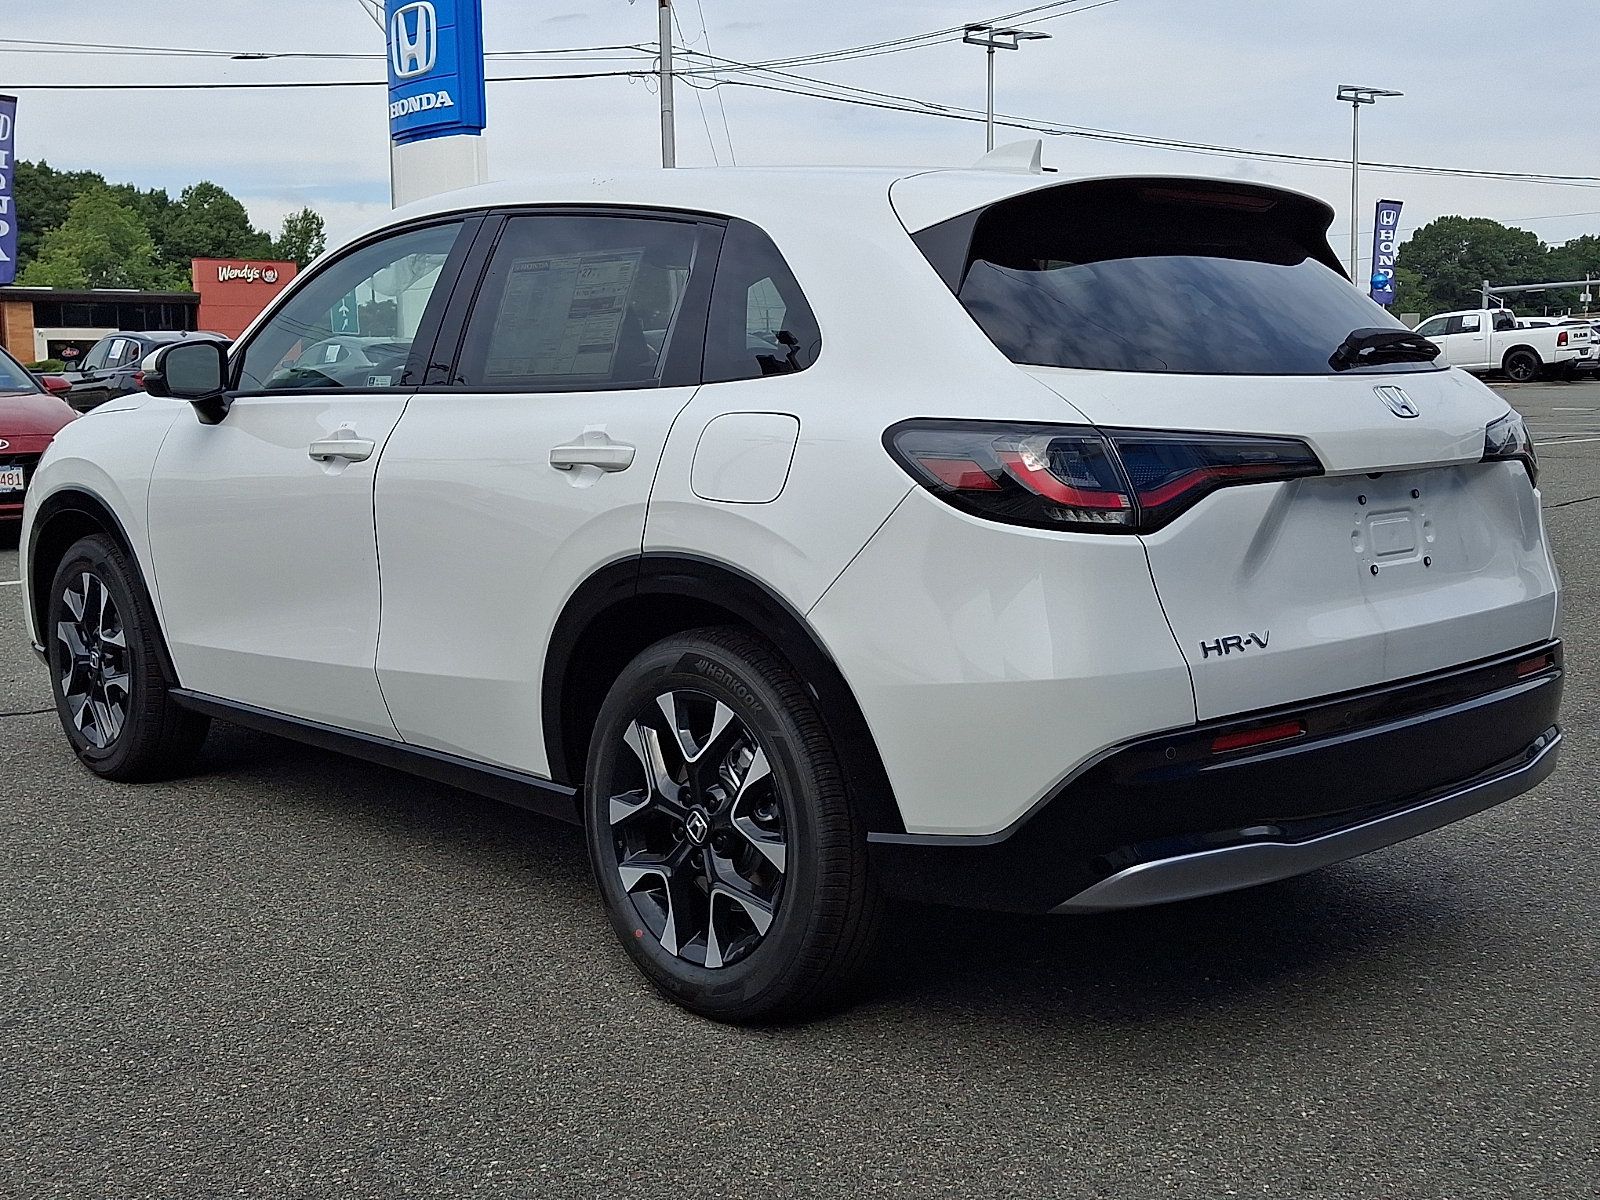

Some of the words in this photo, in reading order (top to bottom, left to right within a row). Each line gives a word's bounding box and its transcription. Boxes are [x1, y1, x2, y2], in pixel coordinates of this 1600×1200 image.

[390, 91, 454, 119] HONDA
[218, 264, 260, 283] Wendy's
[0, 472, 22, 486] 481
[1200, 630, 1269, 659] HR-V
